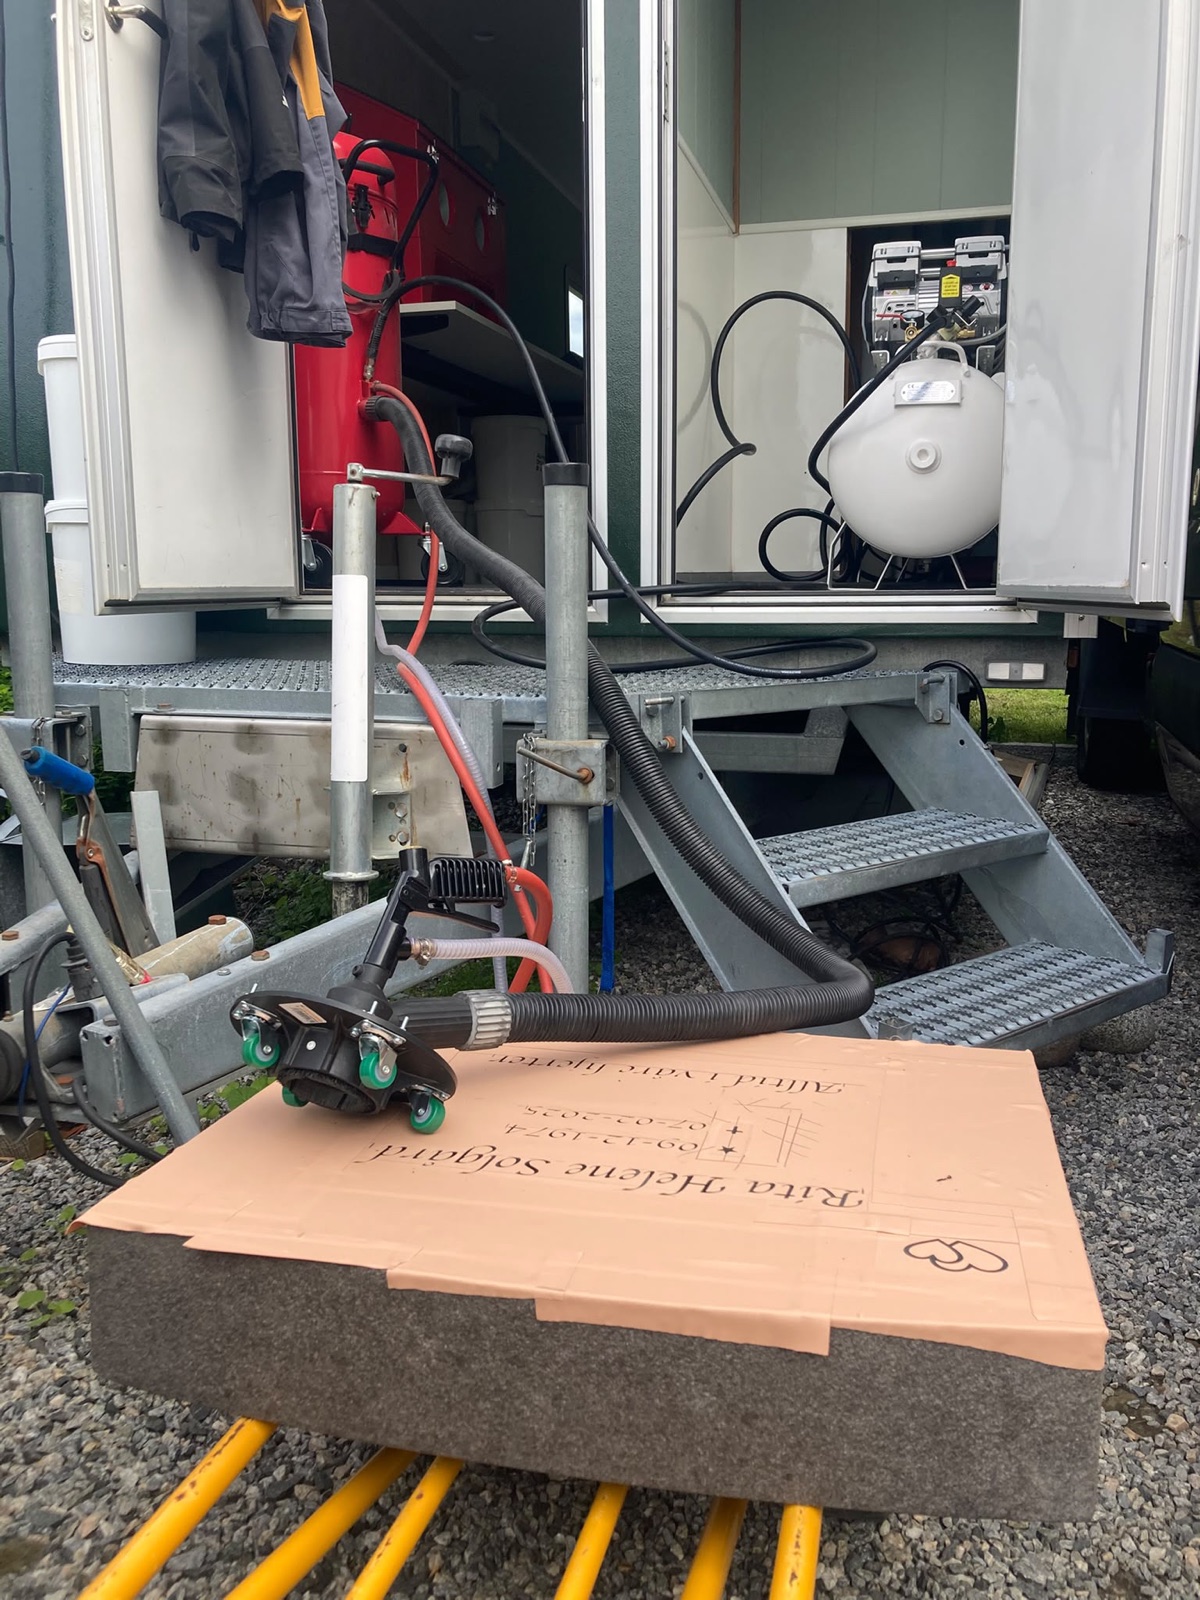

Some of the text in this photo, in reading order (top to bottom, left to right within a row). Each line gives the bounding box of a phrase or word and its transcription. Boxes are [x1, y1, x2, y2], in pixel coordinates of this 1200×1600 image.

[492, 1054, 843, 1094] Alltid i våre hjerter
[525, 1105, 707, 1131] 07-02-2025
[505, 1124, 699, 1152] 09-12-1974
[354, 1145, 864, 1208] Rita Helene Solgård
